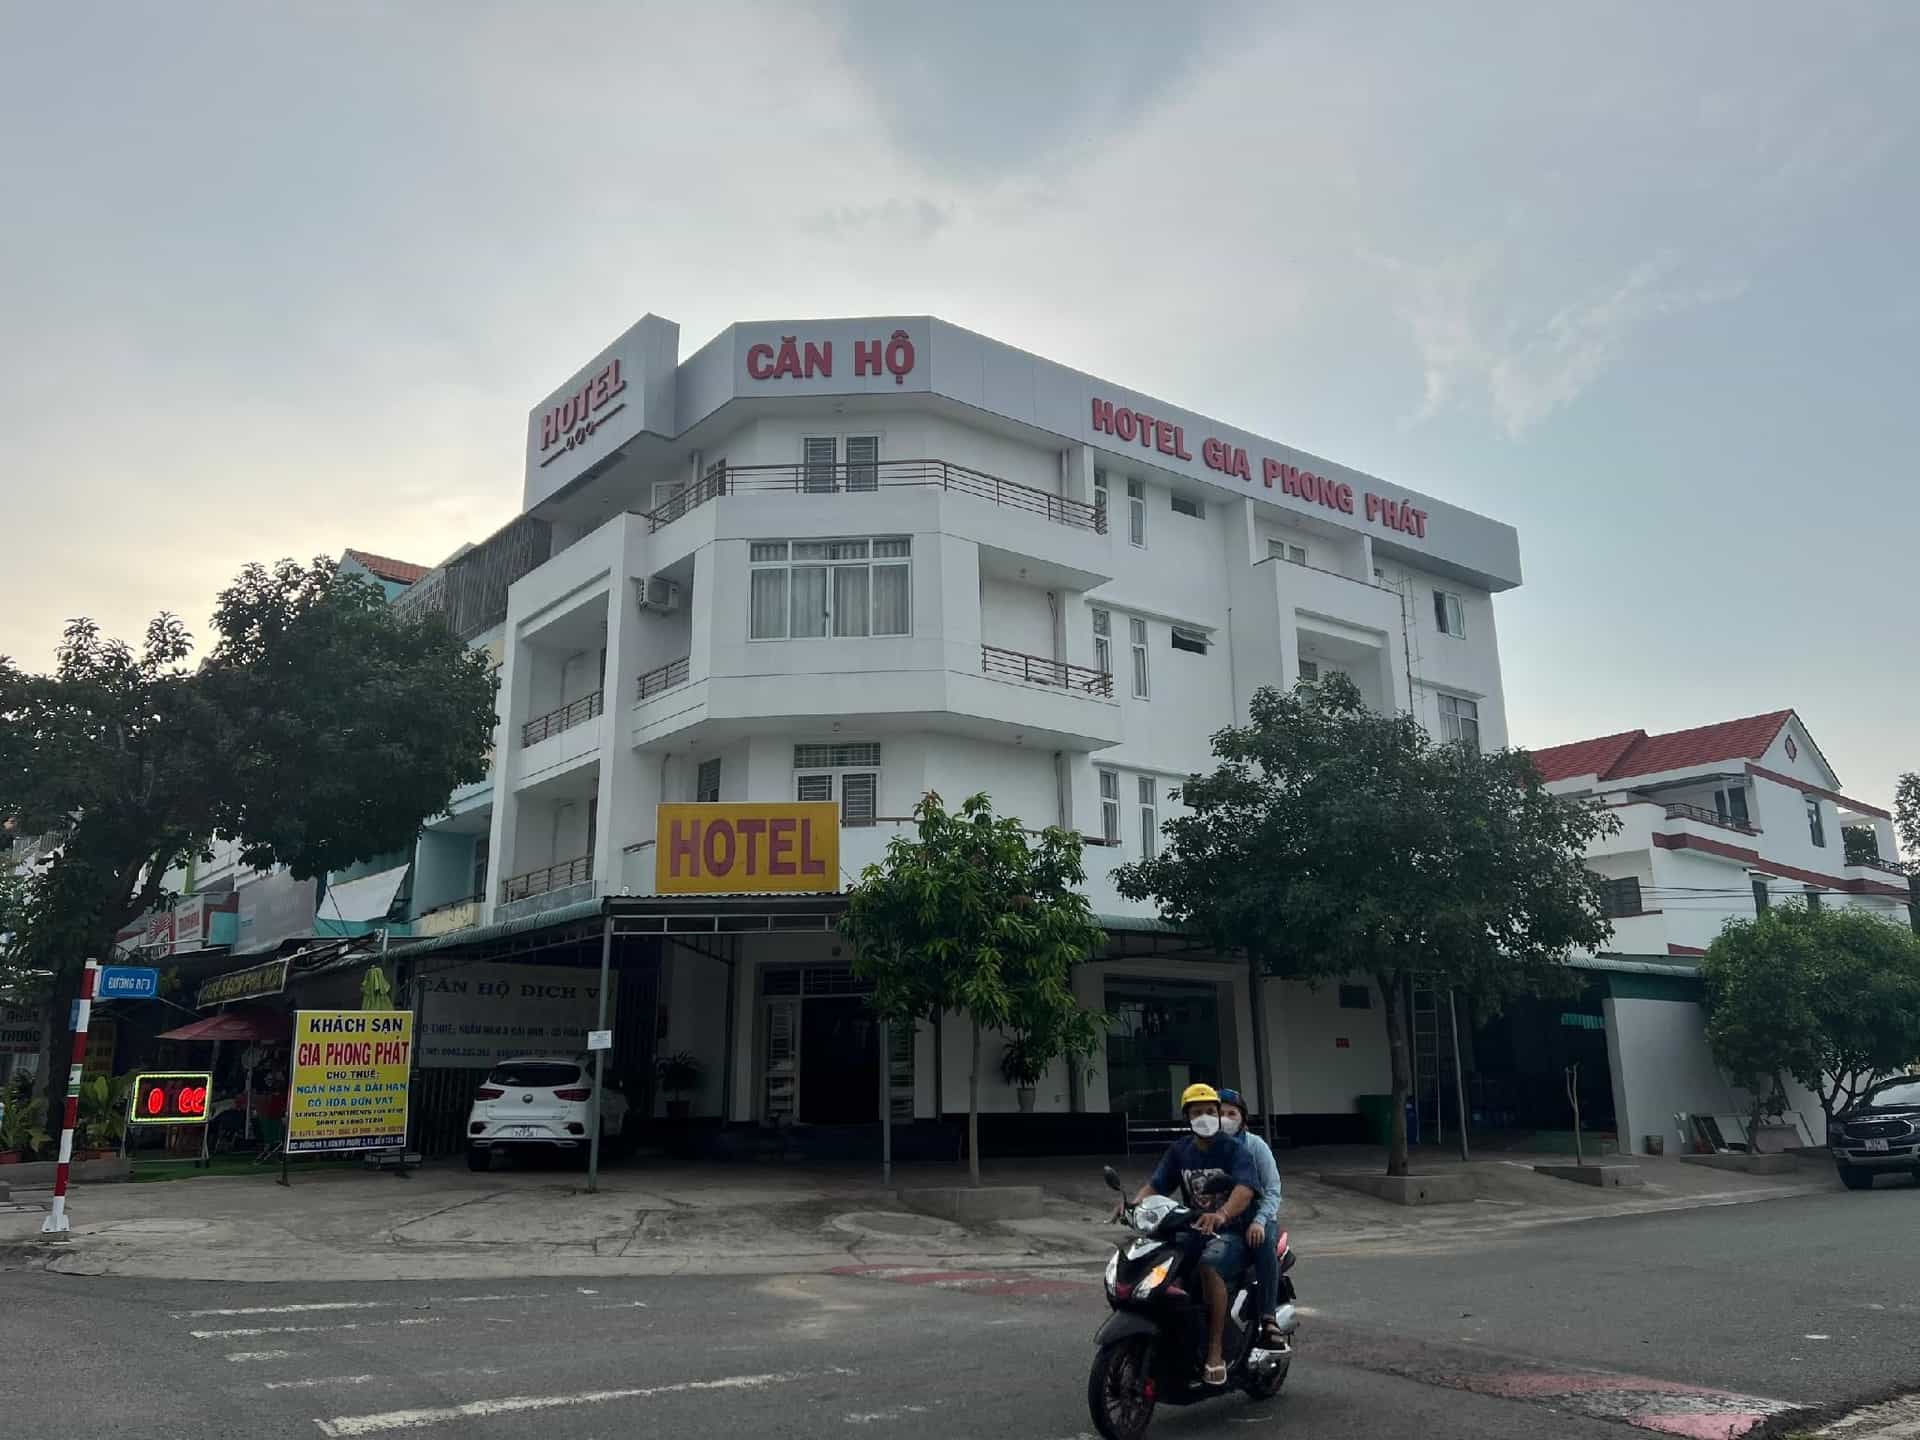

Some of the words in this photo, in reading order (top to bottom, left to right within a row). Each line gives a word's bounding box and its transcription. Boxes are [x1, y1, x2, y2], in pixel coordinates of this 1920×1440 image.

[747, 336, 833, 381] CĂN
[854, 330, 915, 385] HỘ
[540, 359, 627, 452] HOTEL
[1092, 397, 1192, 462] HOTEL
[1203, 437, 1252, 480] GIA
[1263, 457, 1354, 515] PHONG
[1365, 491, 1428, 538] PHÁT
[670, 817, 827, 878] HOTEL
[310, 1015, 366, 1033] KHÁCH
[371, 1018, 403, 1034] SẠN
[298, 1042, 321, 1067] GIA
[326, 1042, 371, 1066] PHONG
[375, 1036, 409, 1065] PHÁT
[327, 1071, 347, 1080] CHO
[375, 1096, 393, 1105] VAT
